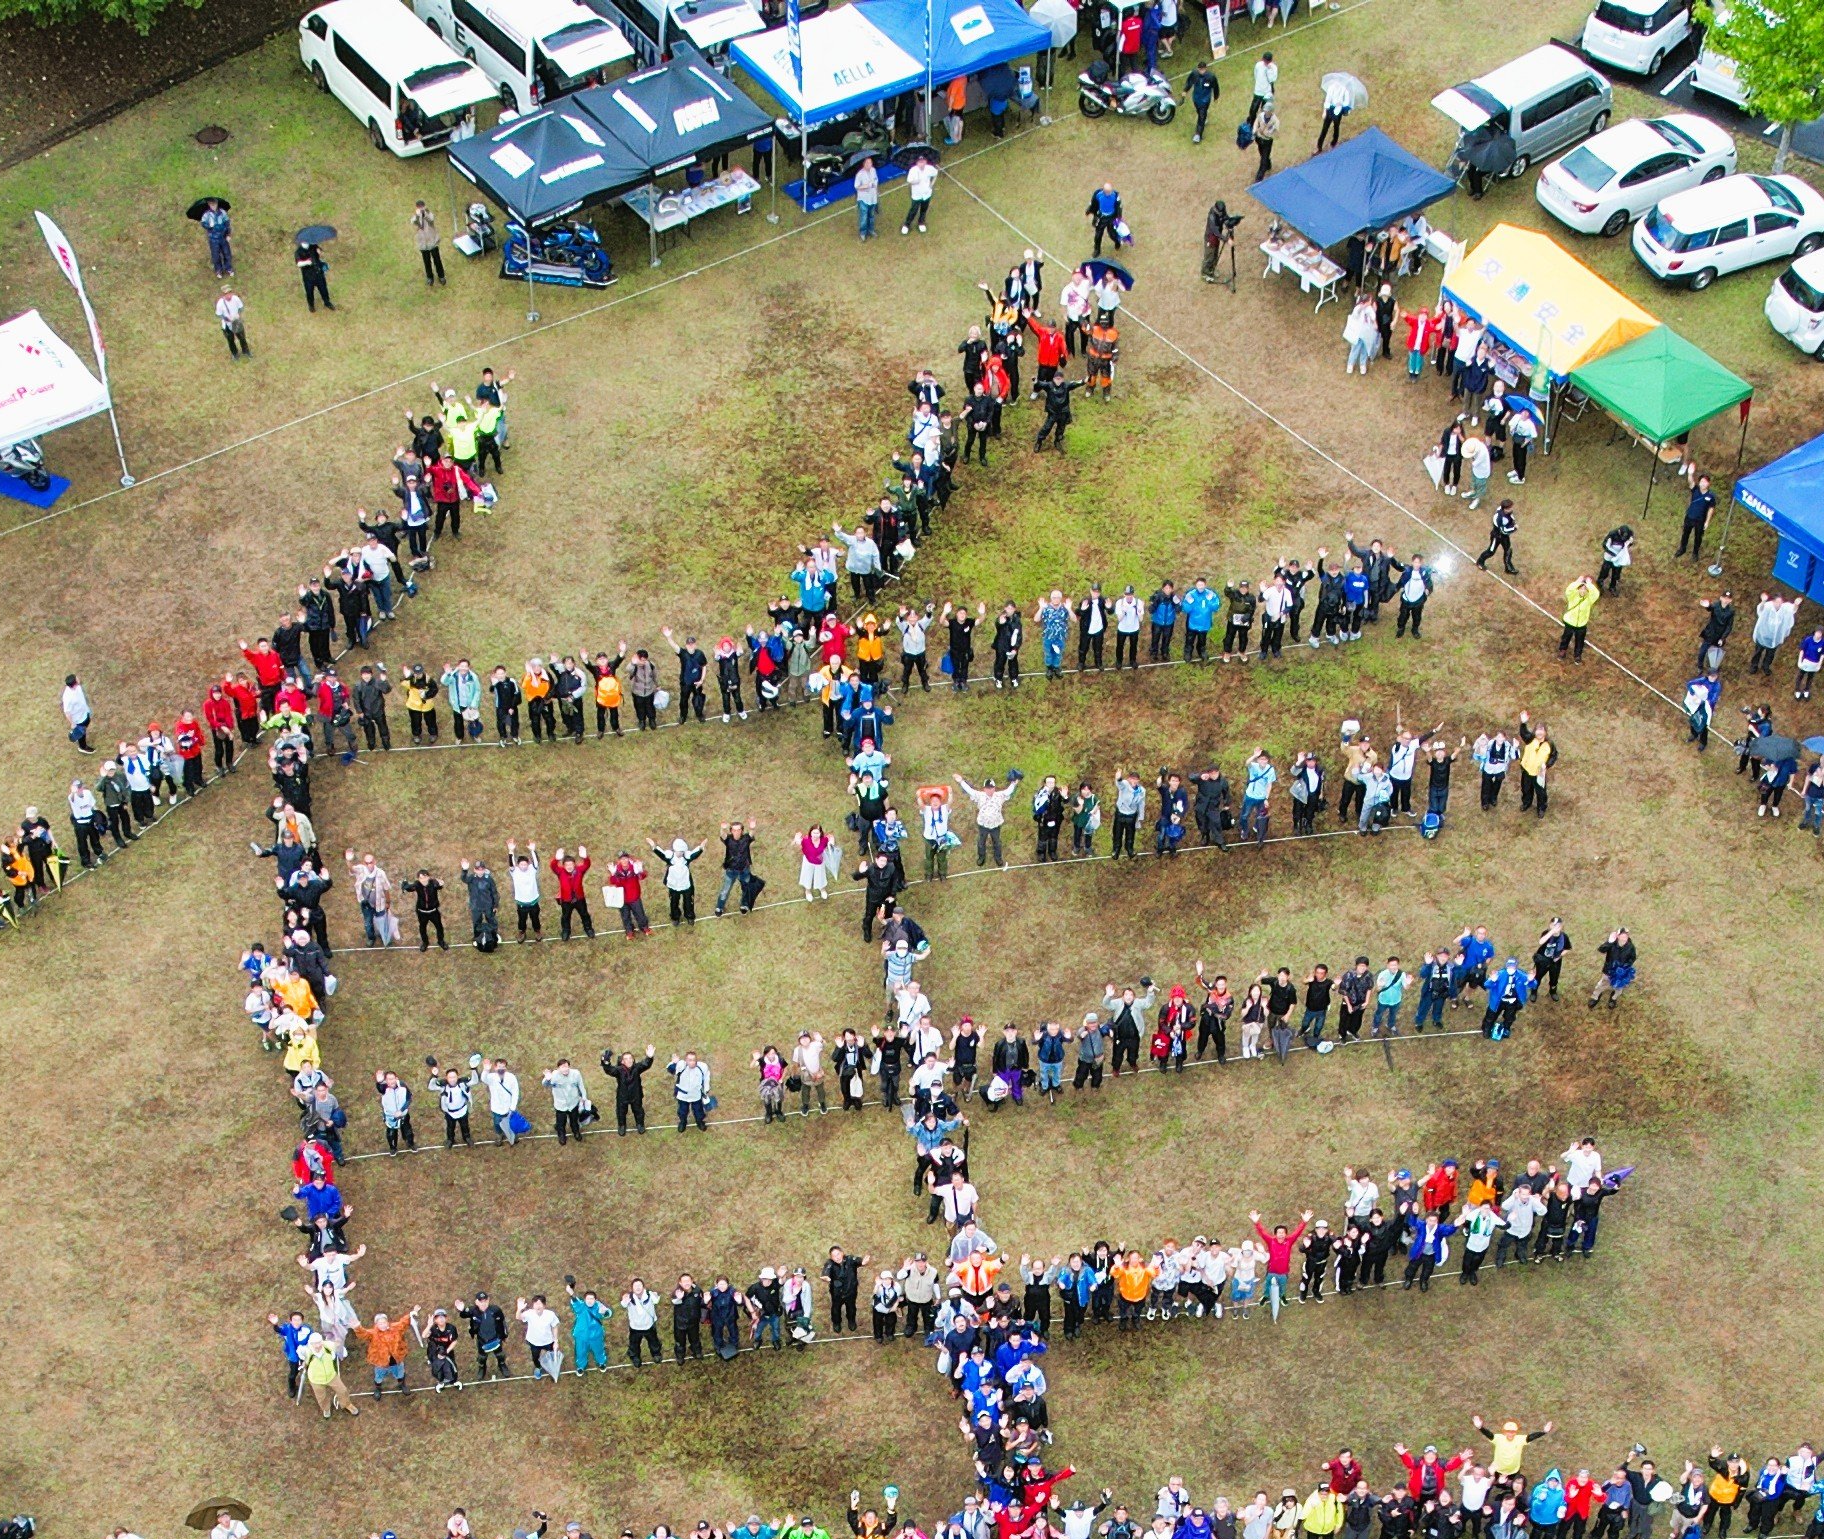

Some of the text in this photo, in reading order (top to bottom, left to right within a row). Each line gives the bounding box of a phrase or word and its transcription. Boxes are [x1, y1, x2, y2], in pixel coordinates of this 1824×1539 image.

[832, 61, 876, 88] AELLA
[1477, 258, 1586, 345] 交通安全
[1741, 489, 1775, 521] TANAX
